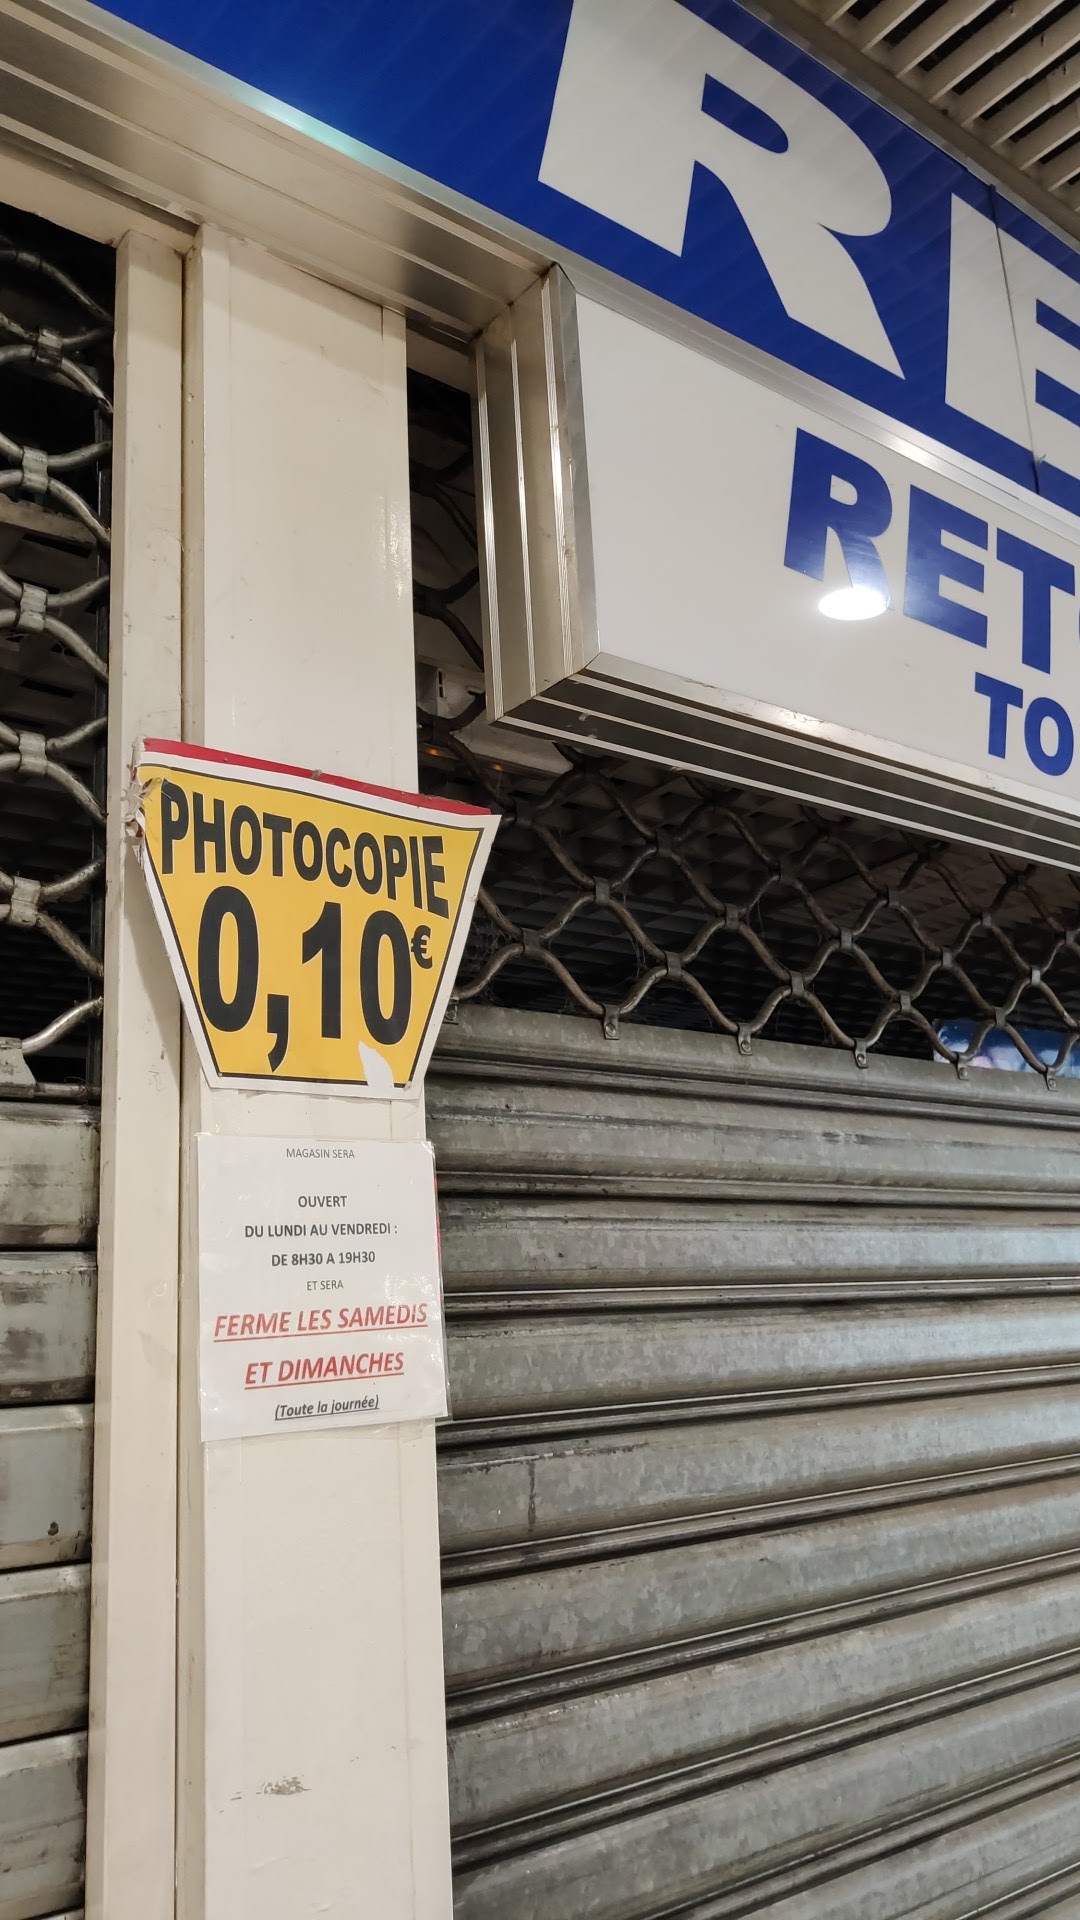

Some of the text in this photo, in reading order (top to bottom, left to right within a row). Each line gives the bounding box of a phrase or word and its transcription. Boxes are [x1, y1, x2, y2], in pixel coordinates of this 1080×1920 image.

[783, 427, 1080, 675] RET
[974, 671, 1074, 776] TO
[161, 777, 449, 919] PHOTOCOPIE
[198, 885, 433, 1072] 0,10€
[286, 1148, 355, 1159] MAGASIN SERA
[298, 1195, 347, 1208] OUVERT
[245, 1225, 264, 1237] DU
[268, 1225, 306, 1237] LUNDI
[310, 1224, 328, 1236] AU
[331, 1223, 391, 1236] VENDREDI
[272, 1251, 375, 1266] DE 8H30 A 19H30
[307, 1280, 344, 1291] ET SERA
[215, 1303, 427, 1337] FERME LES SAMEDIS
[245, 1353, 404, 1385] ET DIMANCHES
[275, 1395, 379, 1420] (Toute la journée)
